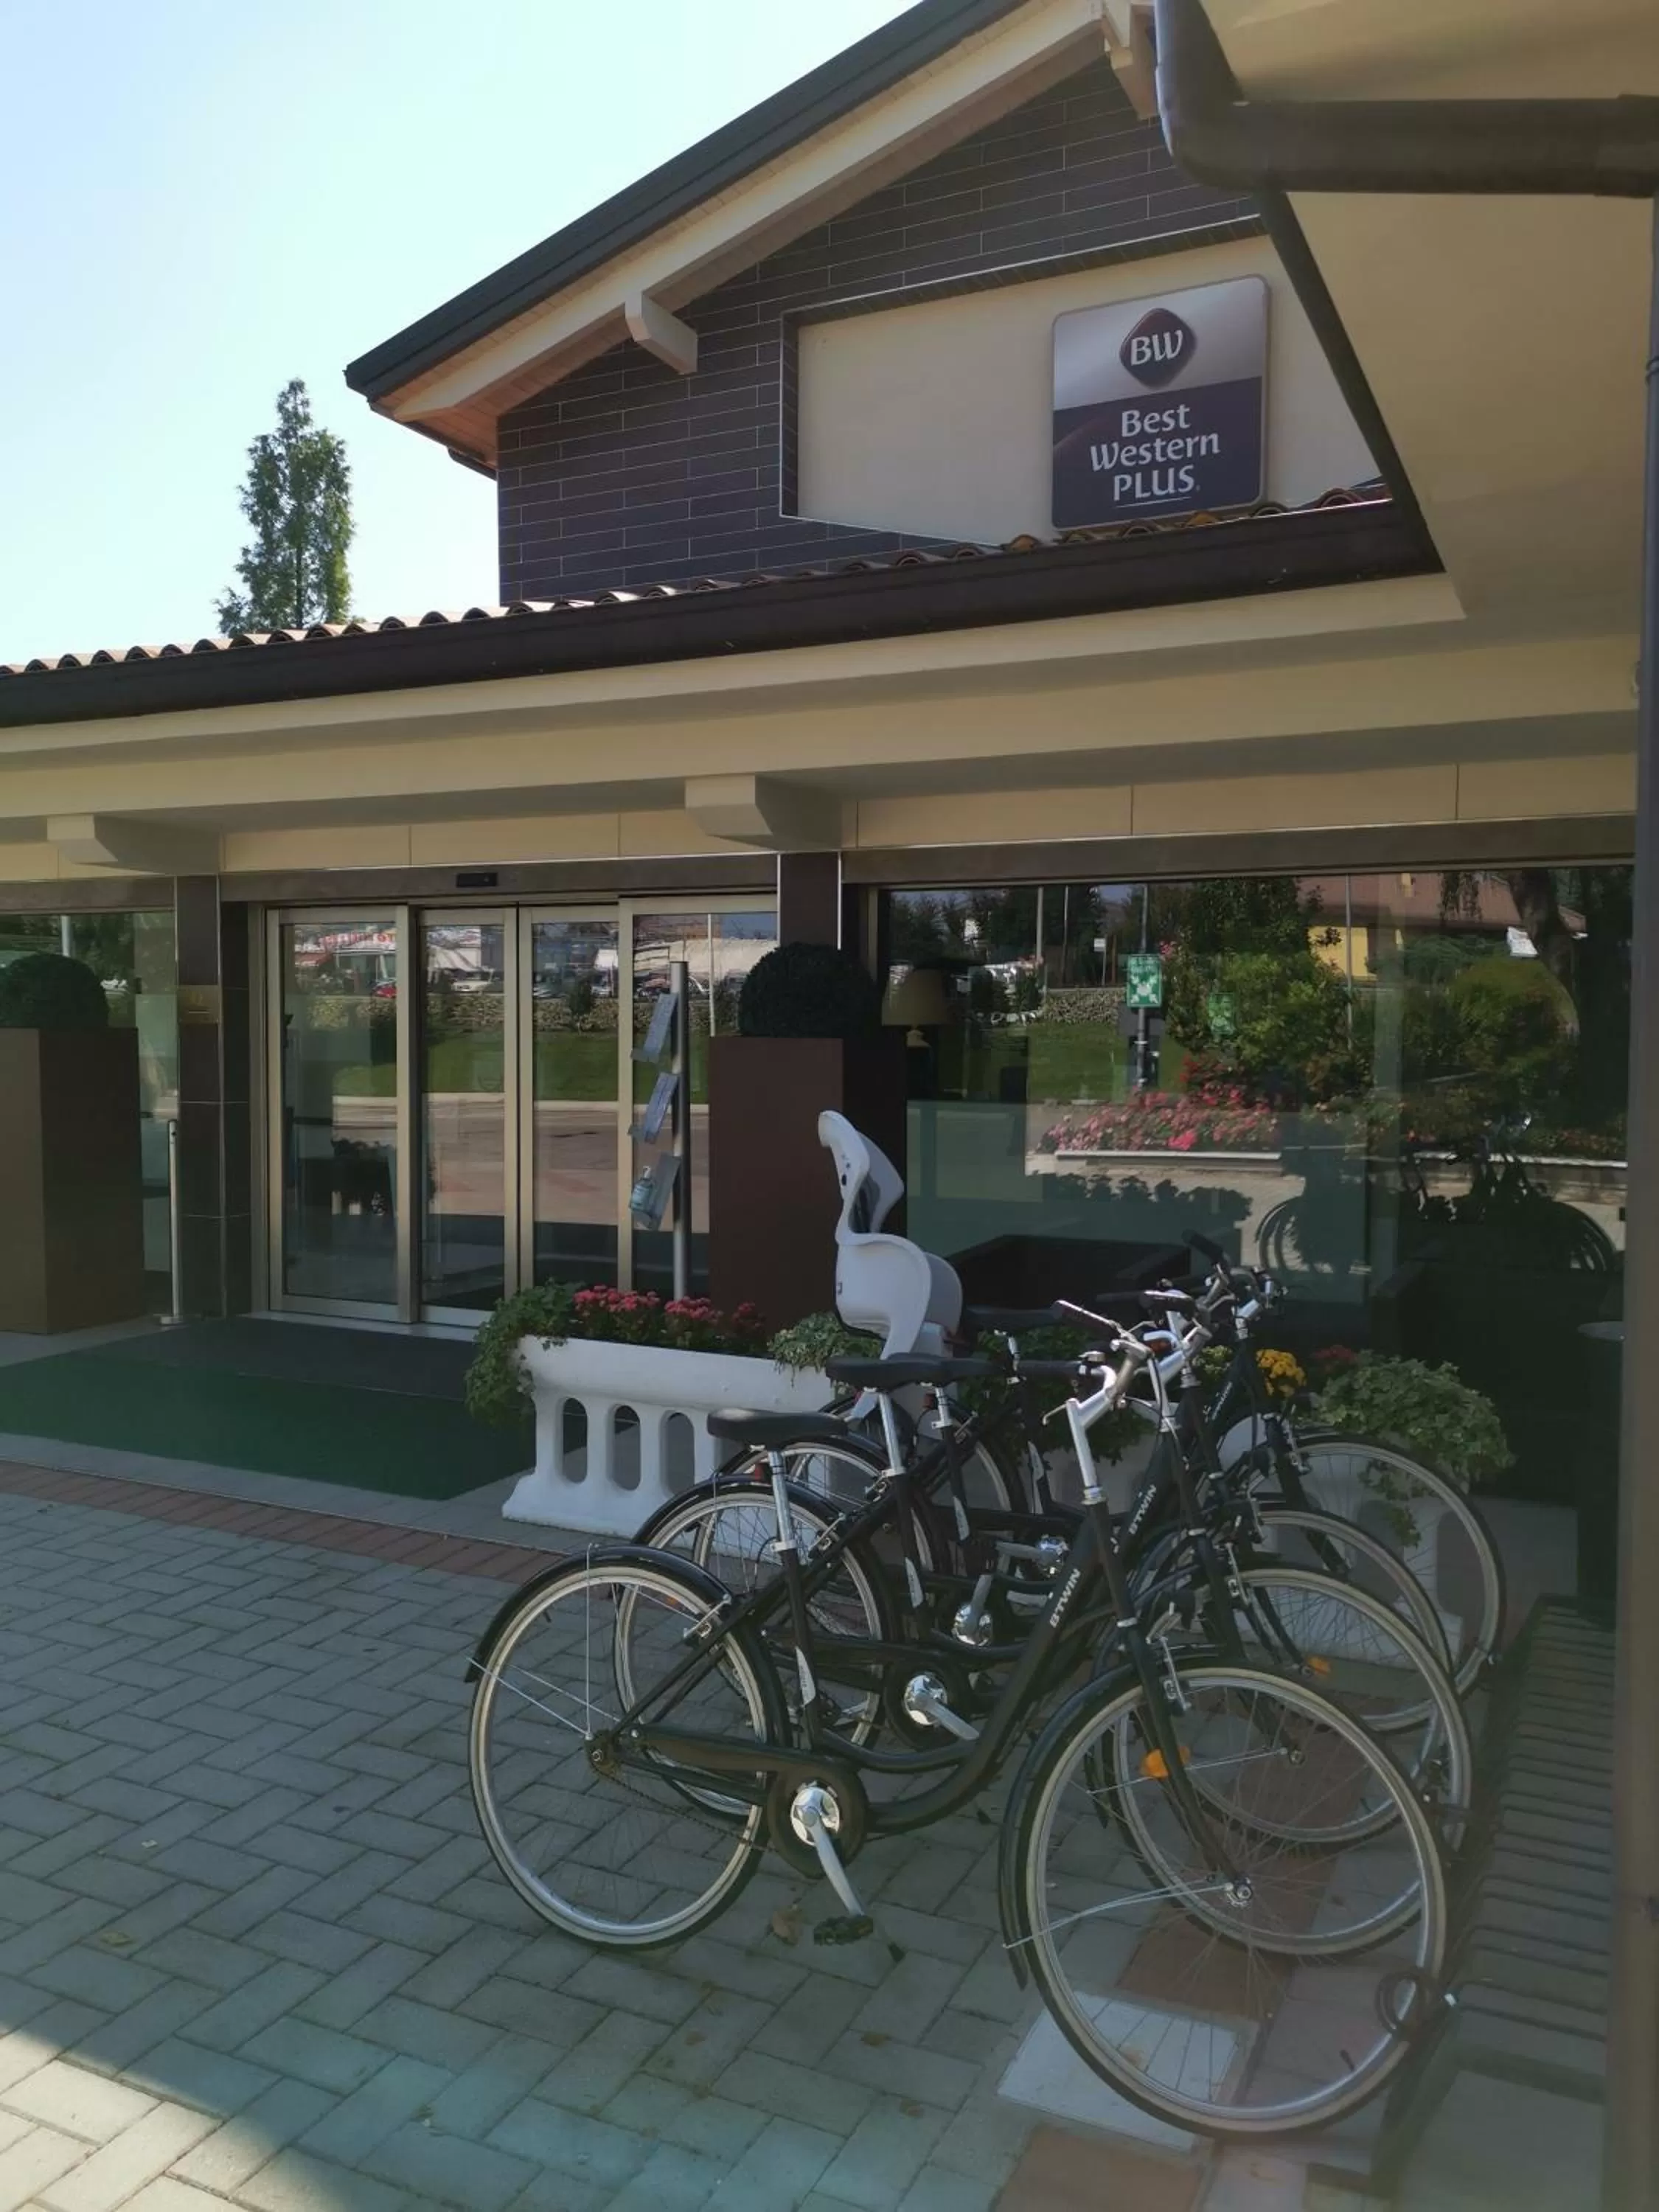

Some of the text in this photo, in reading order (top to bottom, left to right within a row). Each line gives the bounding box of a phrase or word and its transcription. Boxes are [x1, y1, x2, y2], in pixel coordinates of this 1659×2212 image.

[1130, 330, 1183, 366] BW
[1121, 404, 1192, 438] Best
[1090, 432, 1221, 472] Western
[1113, 464, 1196, 501] PLUS
